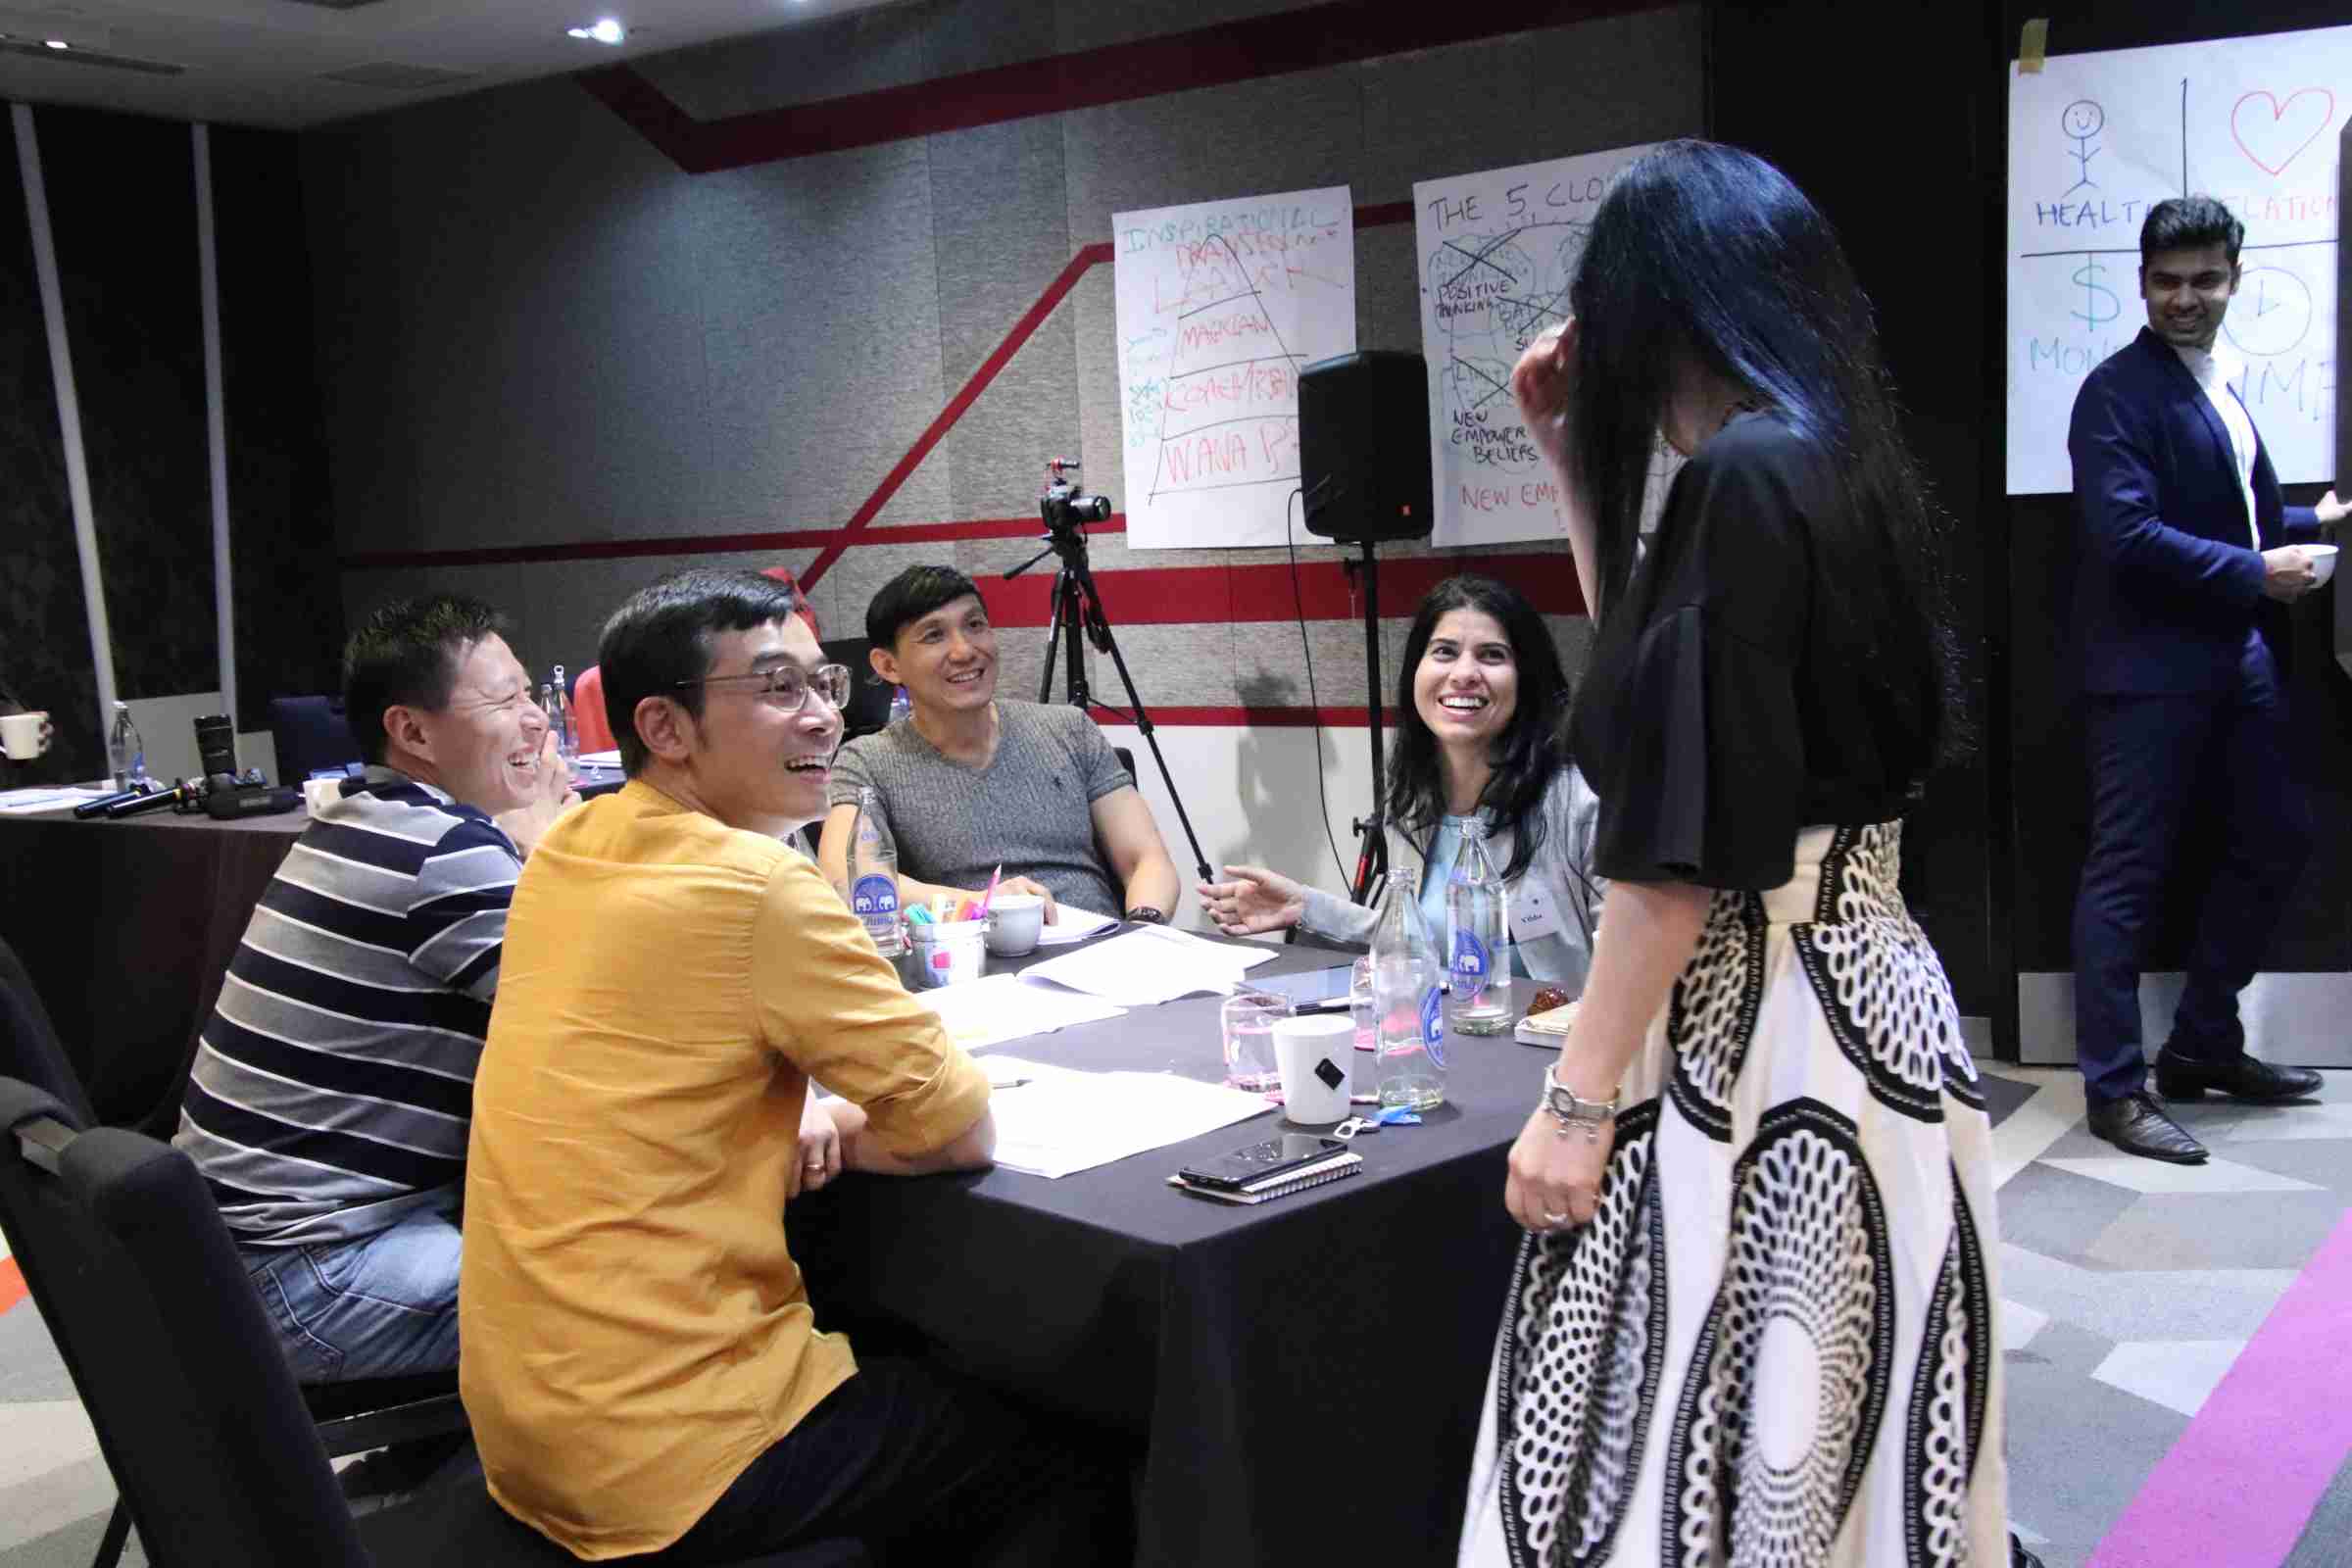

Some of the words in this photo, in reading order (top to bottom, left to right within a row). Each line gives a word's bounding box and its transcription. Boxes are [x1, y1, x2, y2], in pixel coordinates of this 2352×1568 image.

[1428, 195, 1484, 231] THE
[1505, 183, 1530, 218] 5
[1545, 176, 1607, 208] CLO
[1437, 279, 1510, 306] POSITIVE
[2030, 336, 2119, 375] MON
[1453, 409, 1489, 428] NEW
[1450, 425, 1527, 446] EMPOWER
[1473, 445, 1540, 466] BELIEFS
[1460, 484, 1510, 512] NEW
